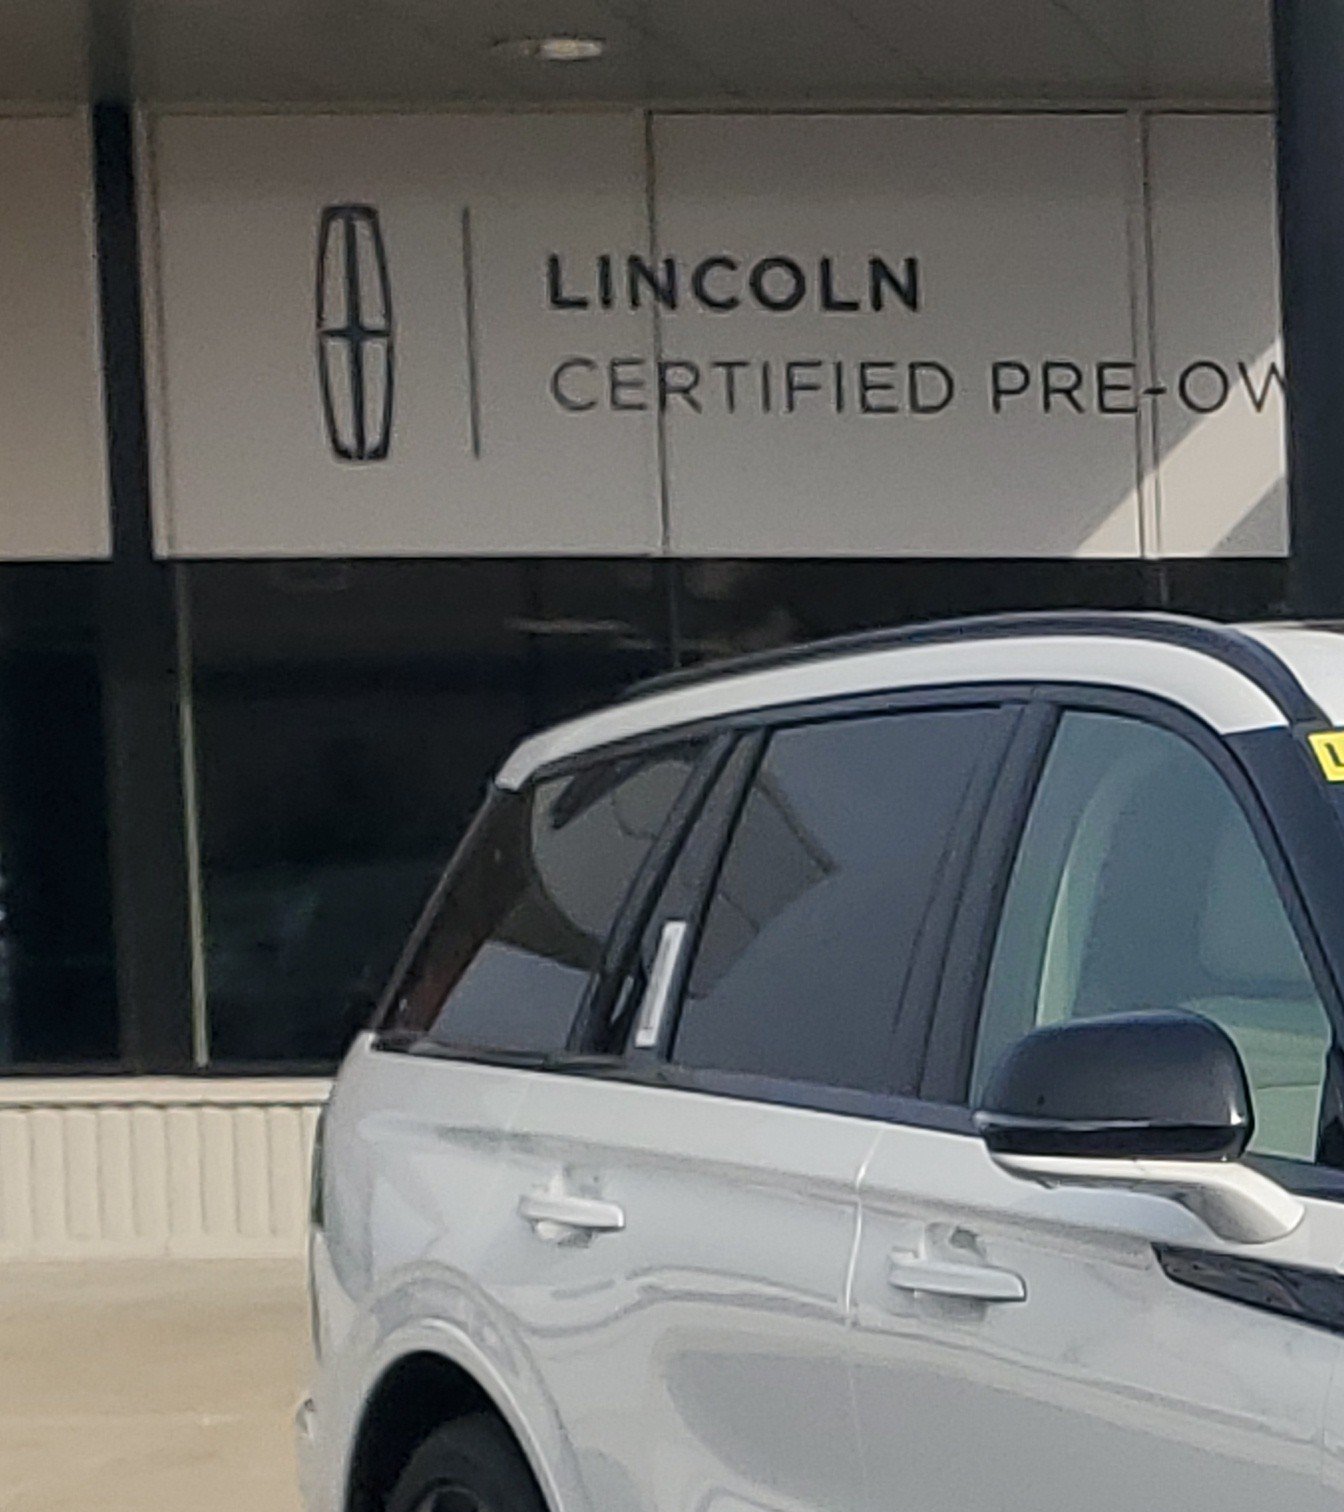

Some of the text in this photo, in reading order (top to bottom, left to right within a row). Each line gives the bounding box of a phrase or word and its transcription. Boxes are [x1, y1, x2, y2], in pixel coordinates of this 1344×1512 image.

[547, 254, 919, 313] LINCOLN
[551, 357, 1285, 414] CERTIFIED PRE-OW
